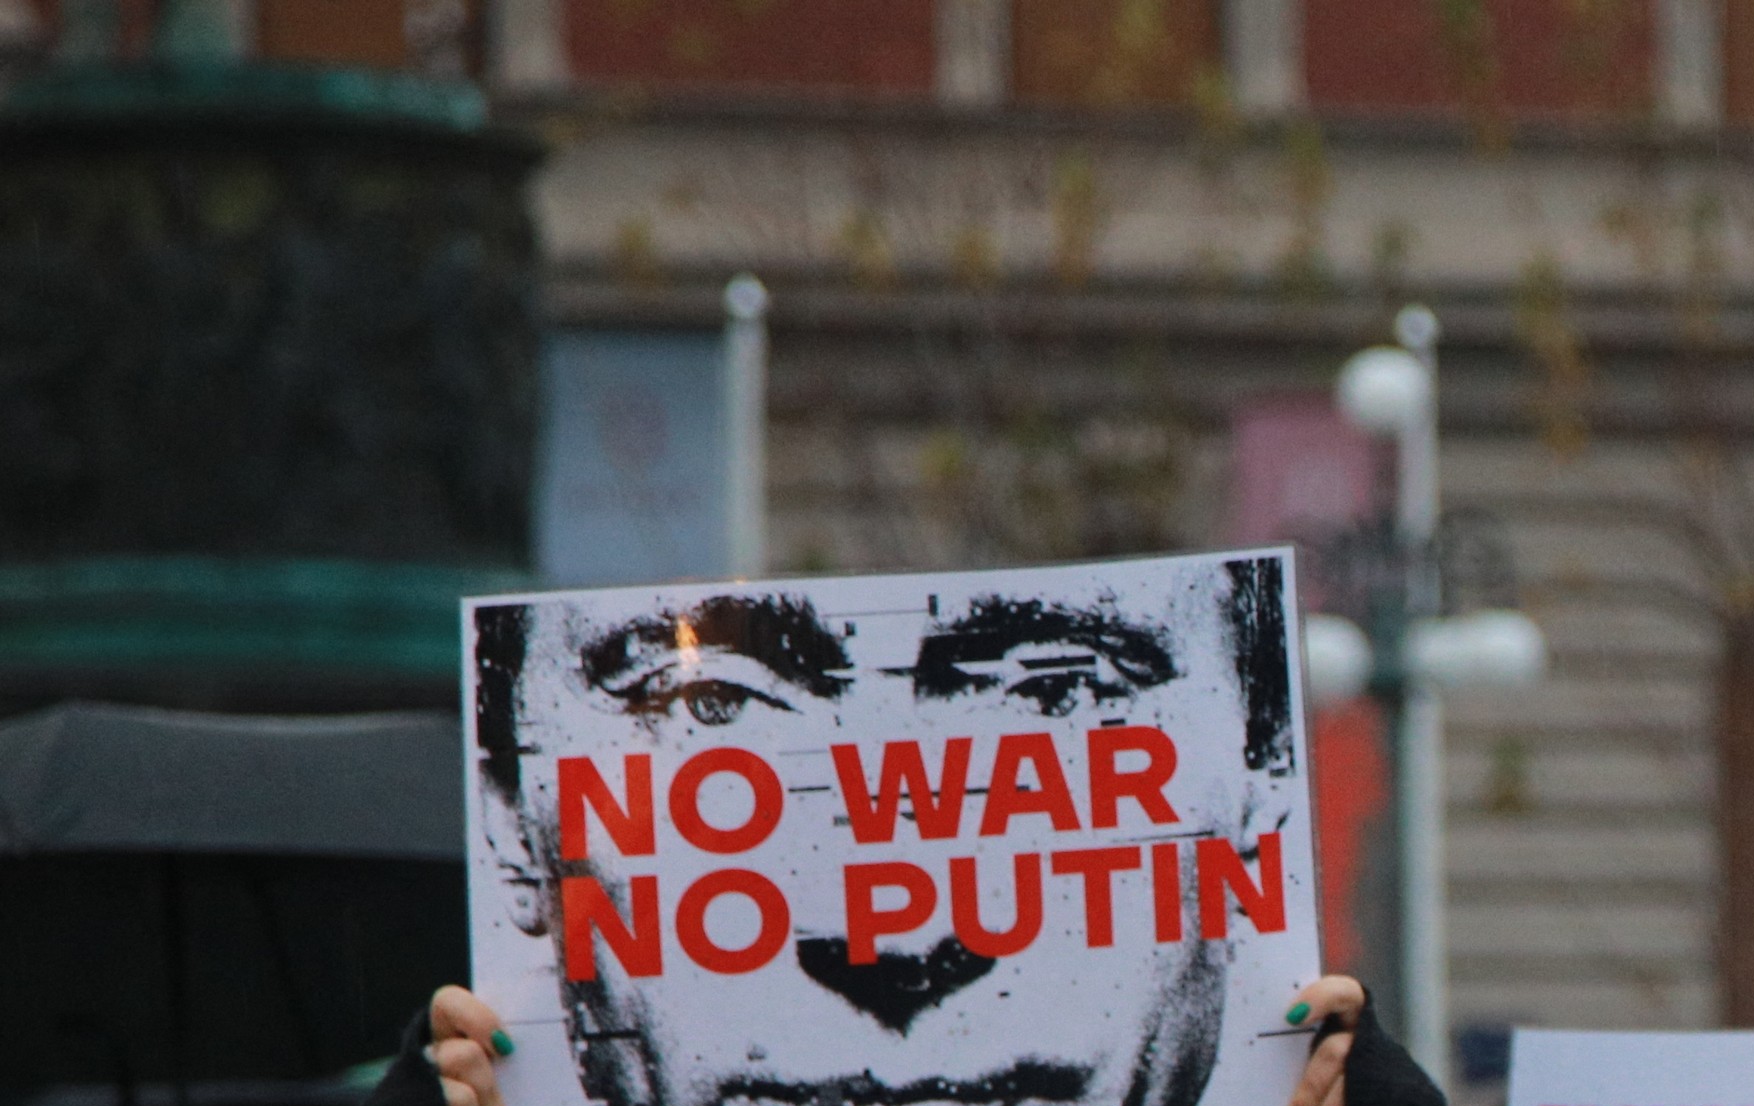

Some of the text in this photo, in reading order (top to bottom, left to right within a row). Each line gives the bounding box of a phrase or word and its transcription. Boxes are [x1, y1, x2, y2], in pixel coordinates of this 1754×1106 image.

[556, 726, 1181, 861] NO WAR
[560, 832, 1287, 983] NO PUTIN
